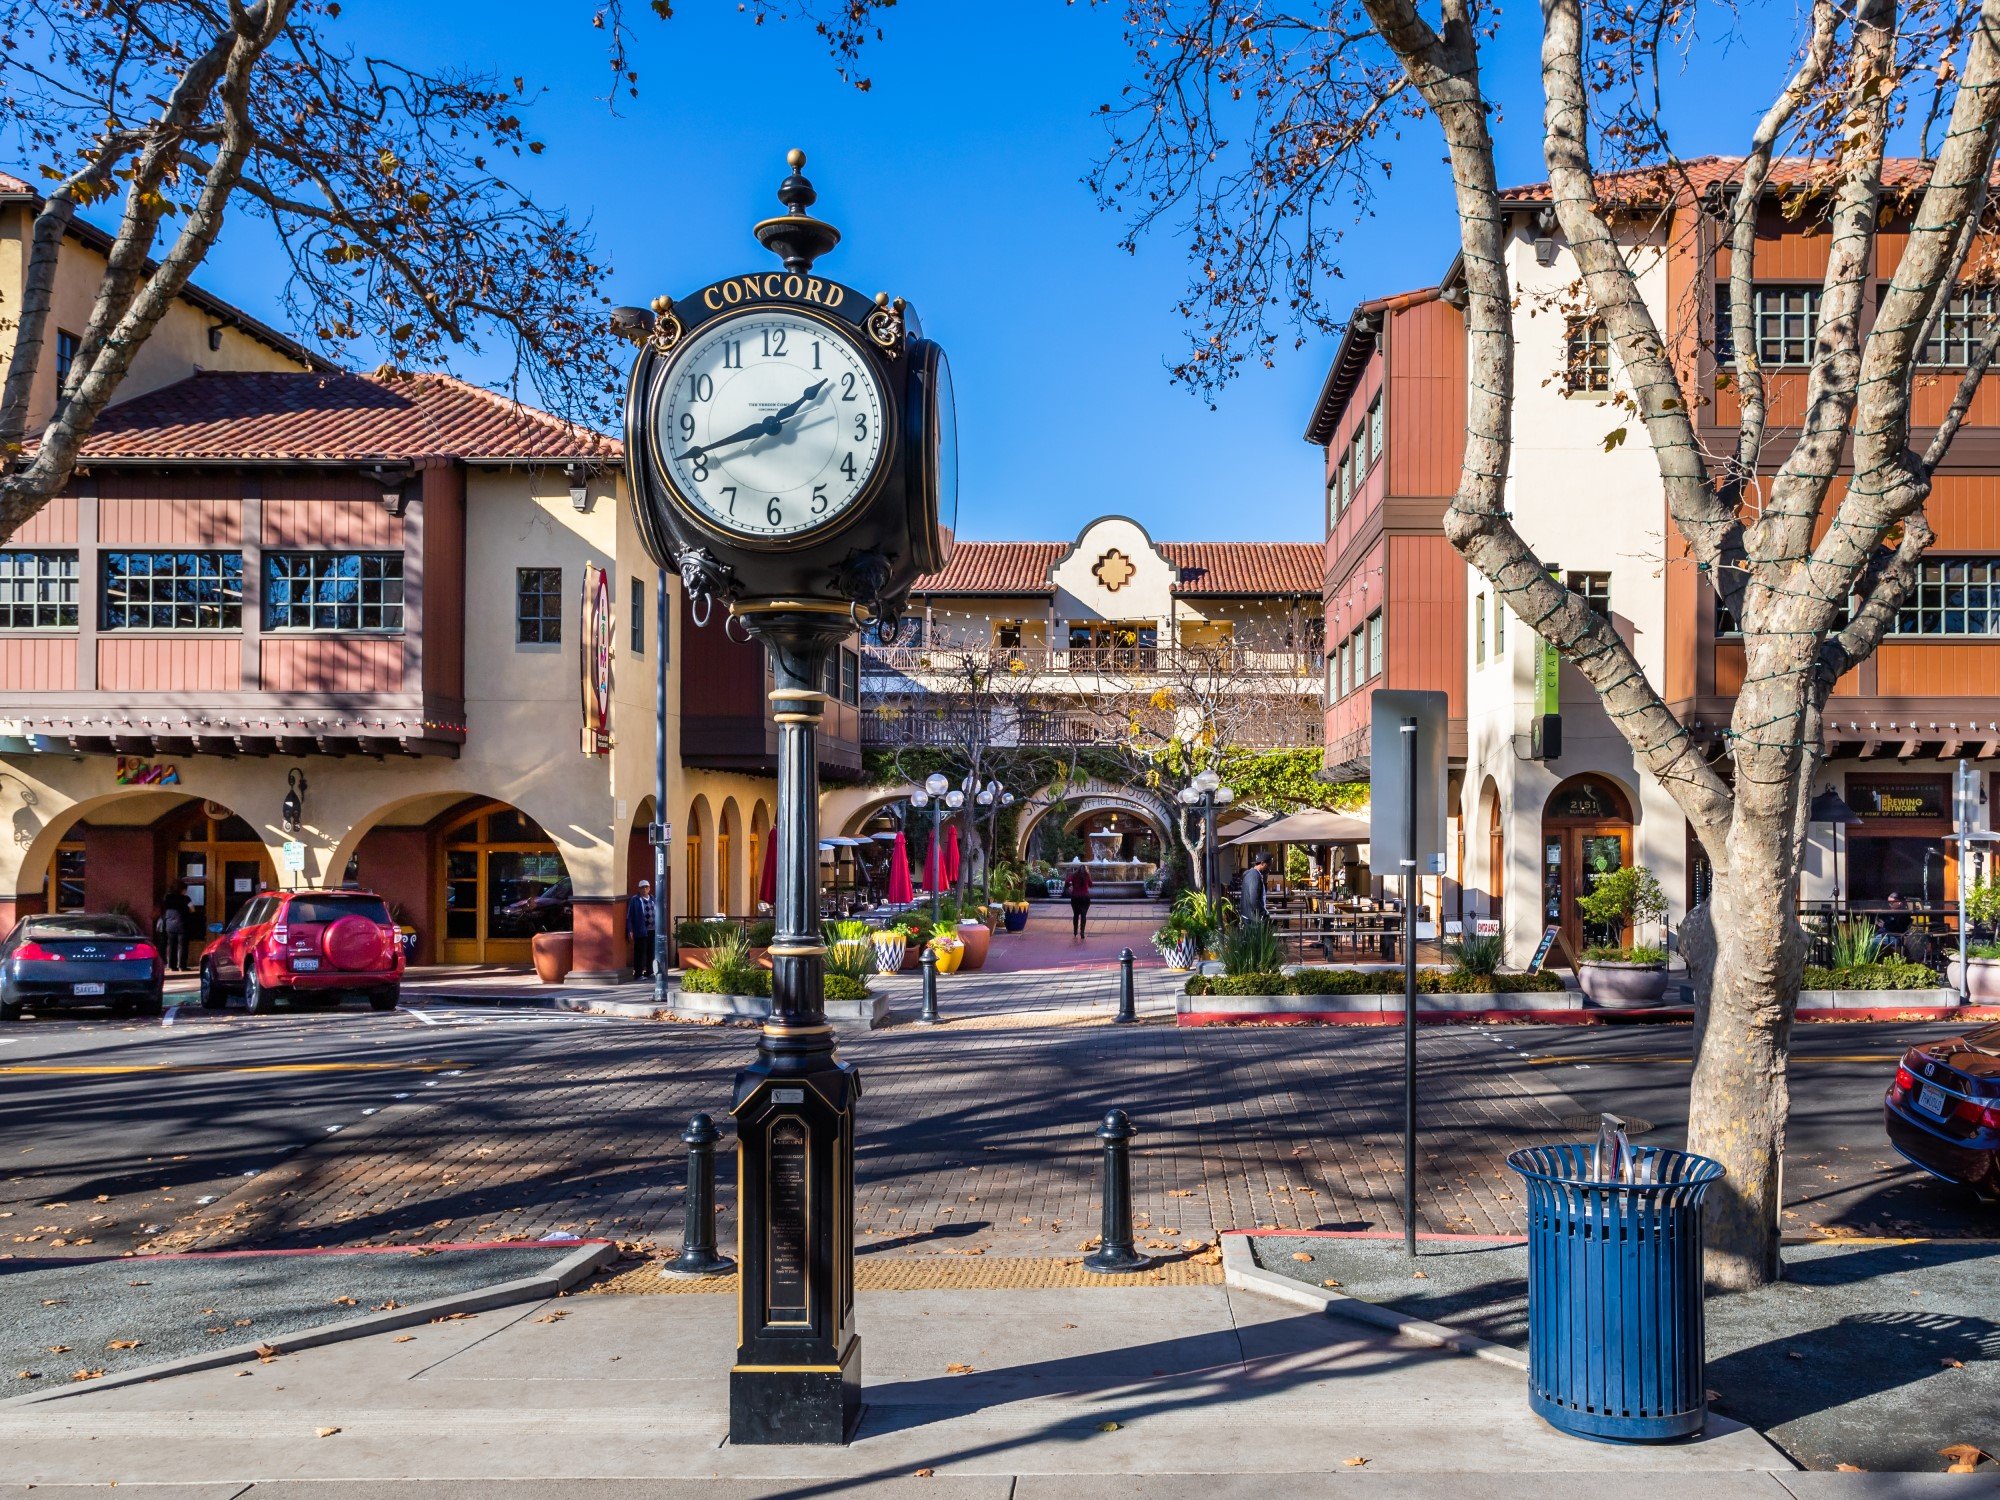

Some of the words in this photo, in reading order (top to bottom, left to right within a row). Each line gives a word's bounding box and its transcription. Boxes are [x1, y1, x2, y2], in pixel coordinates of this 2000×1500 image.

[704, 274, 844, 310] CONCORD
[723, 340, 743, 369] 11
[761, 328, 789, 357] 12
[811, 341, 823, 370] 1
[688, 373, 714, 403] 10
[841, 372, 858, 402] 2
[680, 413, 695, 442] 9
[854, 413, 868, 442] 3
[692, 453, 709, 483] 8
[840, 452, 857, 482] 4
[719, 486, 737, 516] 7
[767, 497, 782, 526] 6
[811, 483, 828, 514] 5
[1548, 651, 1556, 688] CRAF
[1570, 801, 1597, 809] 2151
[1882, 798, 1923, 806] BREWING
